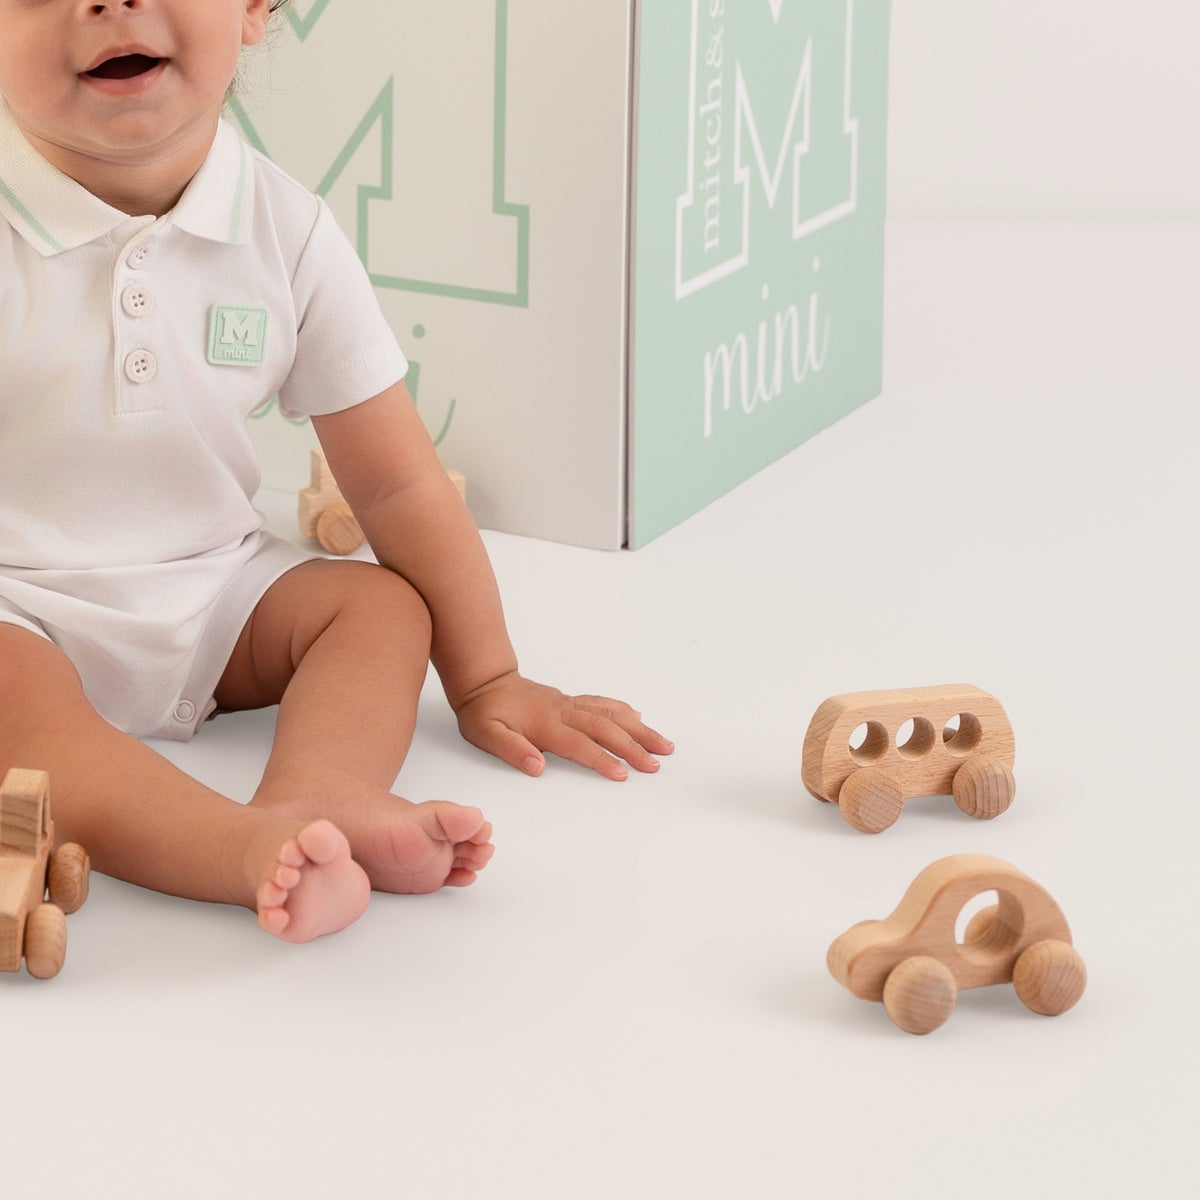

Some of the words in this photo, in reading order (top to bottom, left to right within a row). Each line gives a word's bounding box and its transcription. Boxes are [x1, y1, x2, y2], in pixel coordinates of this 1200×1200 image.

[220, 311, 261, 346] M
[224, 346, 253, 359] mini
[704, 256, 831, 439] mini
